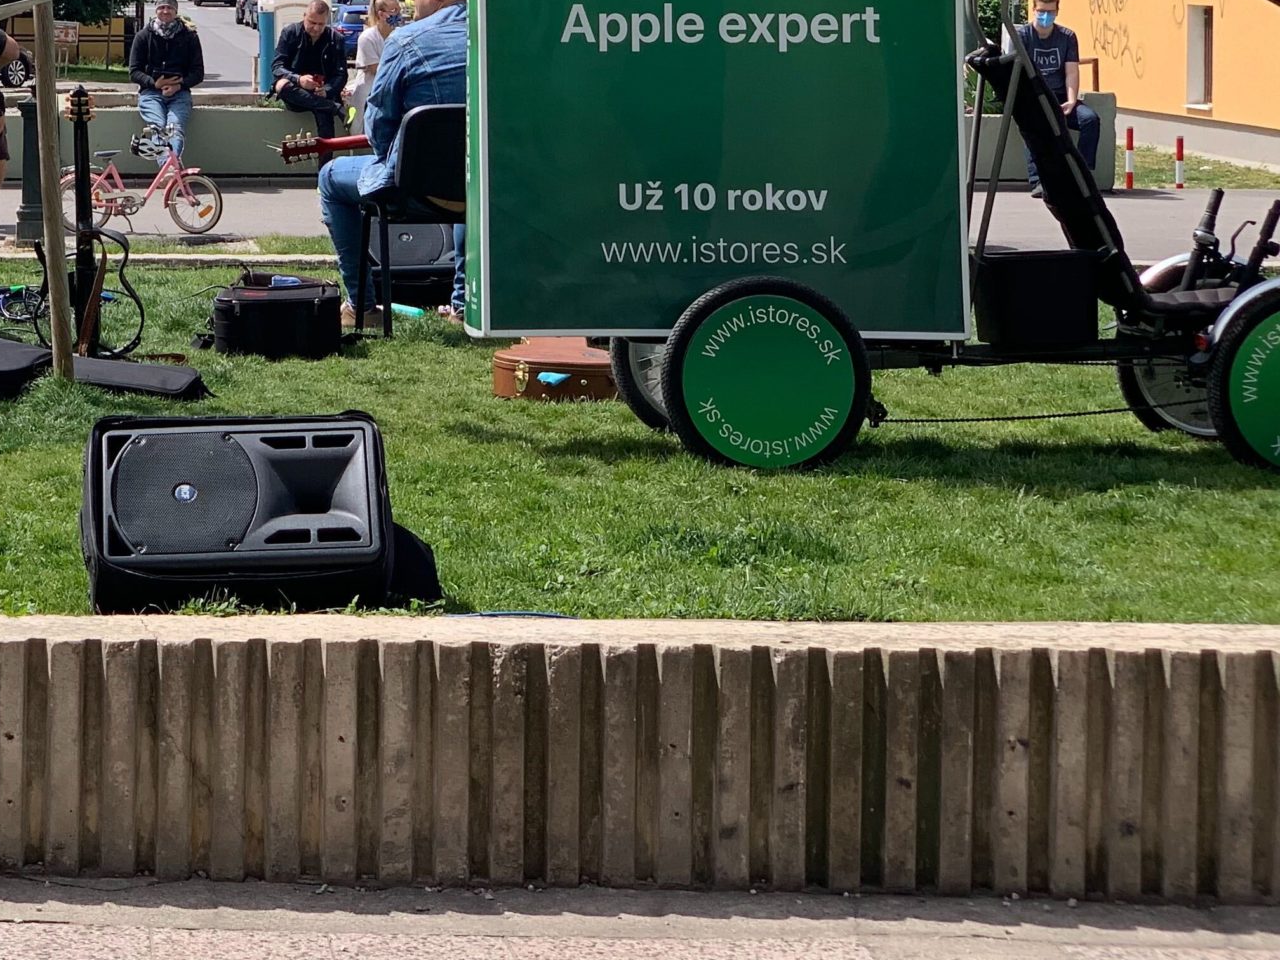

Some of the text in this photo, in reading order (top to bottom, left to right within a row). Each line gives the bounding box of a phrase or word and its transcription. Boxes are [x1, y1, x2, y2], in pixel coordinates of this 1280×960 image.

[560, 2, 881, 53] Apple expert
[1037, 55, 1057, 65] NYC
[618, 180, 828, 212] Už 10 rokov
[601, 235, 848, 264] www.istores.sk
[701, 305, 842, 365] www.istores.sk
[698, 397, 839, 459] www.istores.sk
